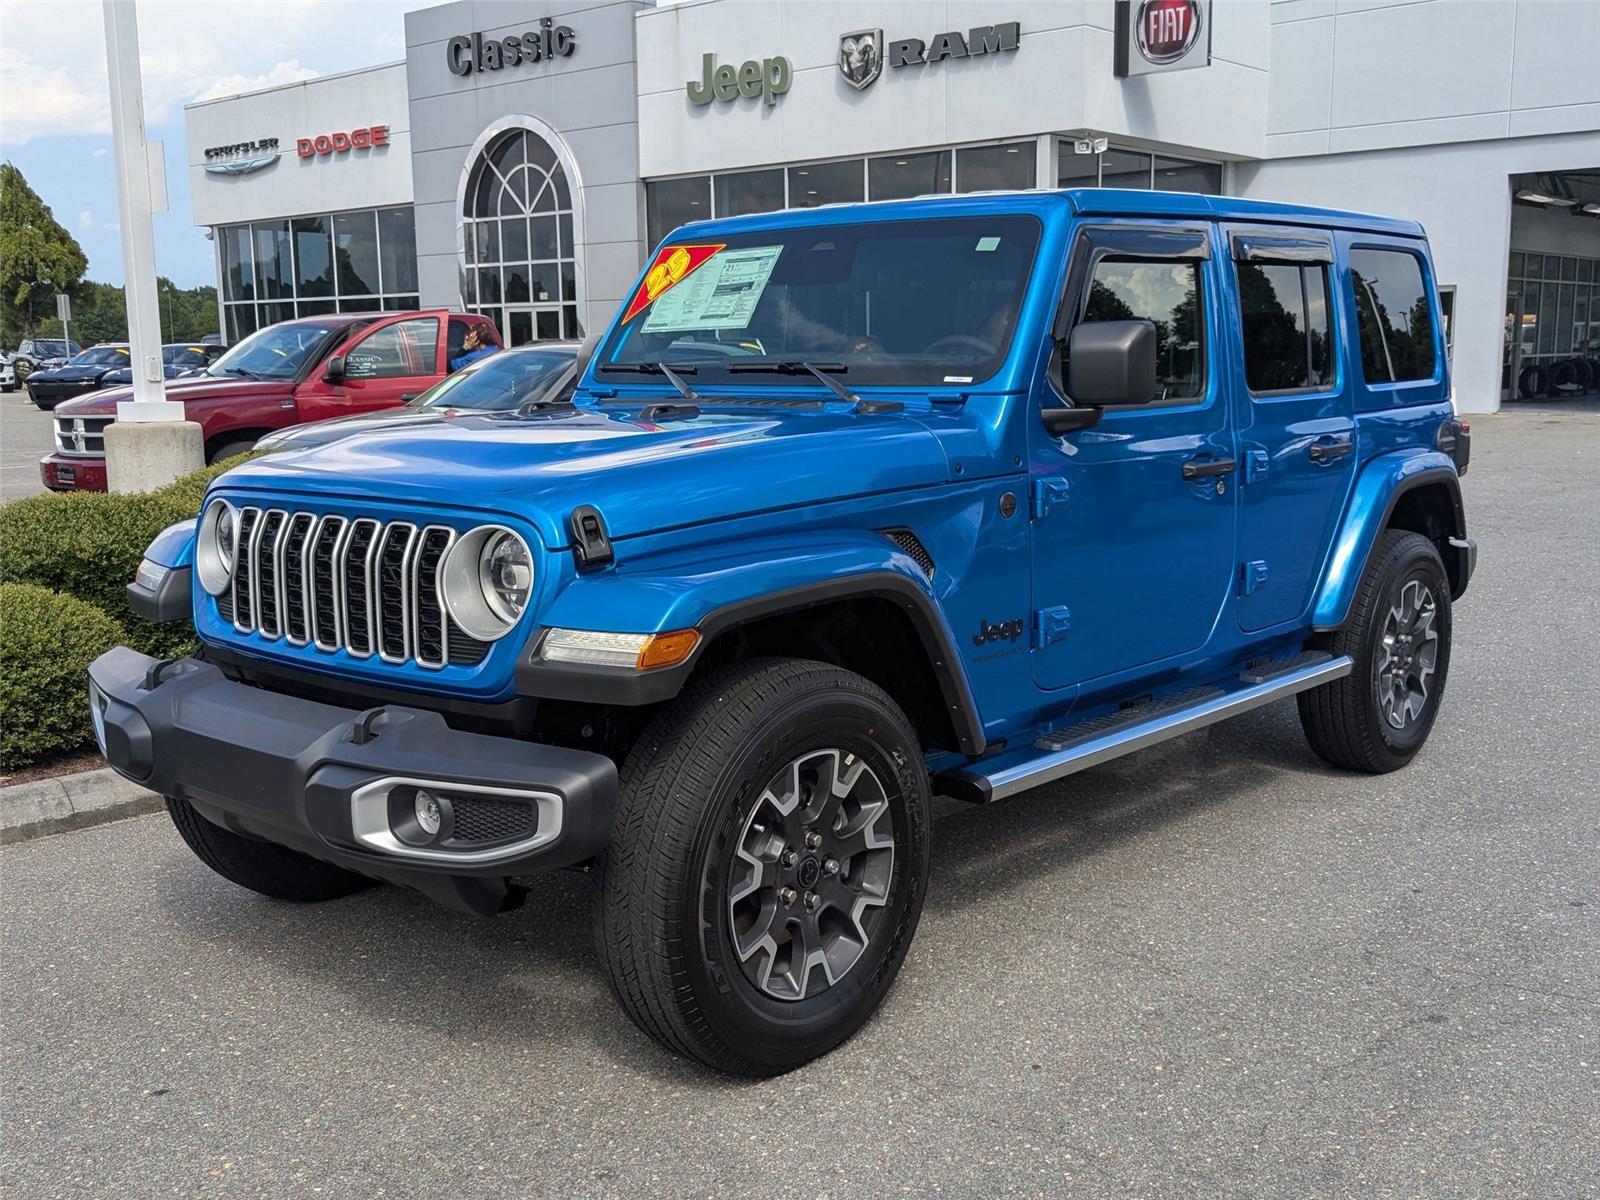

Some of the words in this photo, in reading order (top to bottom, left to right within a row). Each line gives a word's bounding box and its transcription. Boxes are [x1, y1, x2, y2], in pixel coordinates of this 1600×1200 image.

[888, 21, 1021, 68] RAM
[1149, 6, 1187, 45] FIAT
[447, 17, 576, 76] Classic
[686, 52, 793, 106] Jeep
[204, 138, 279, 159] CHRYSLER
[297, 125, 390, 158] DODGE
[972, 618, 1024, 646] Jeep
